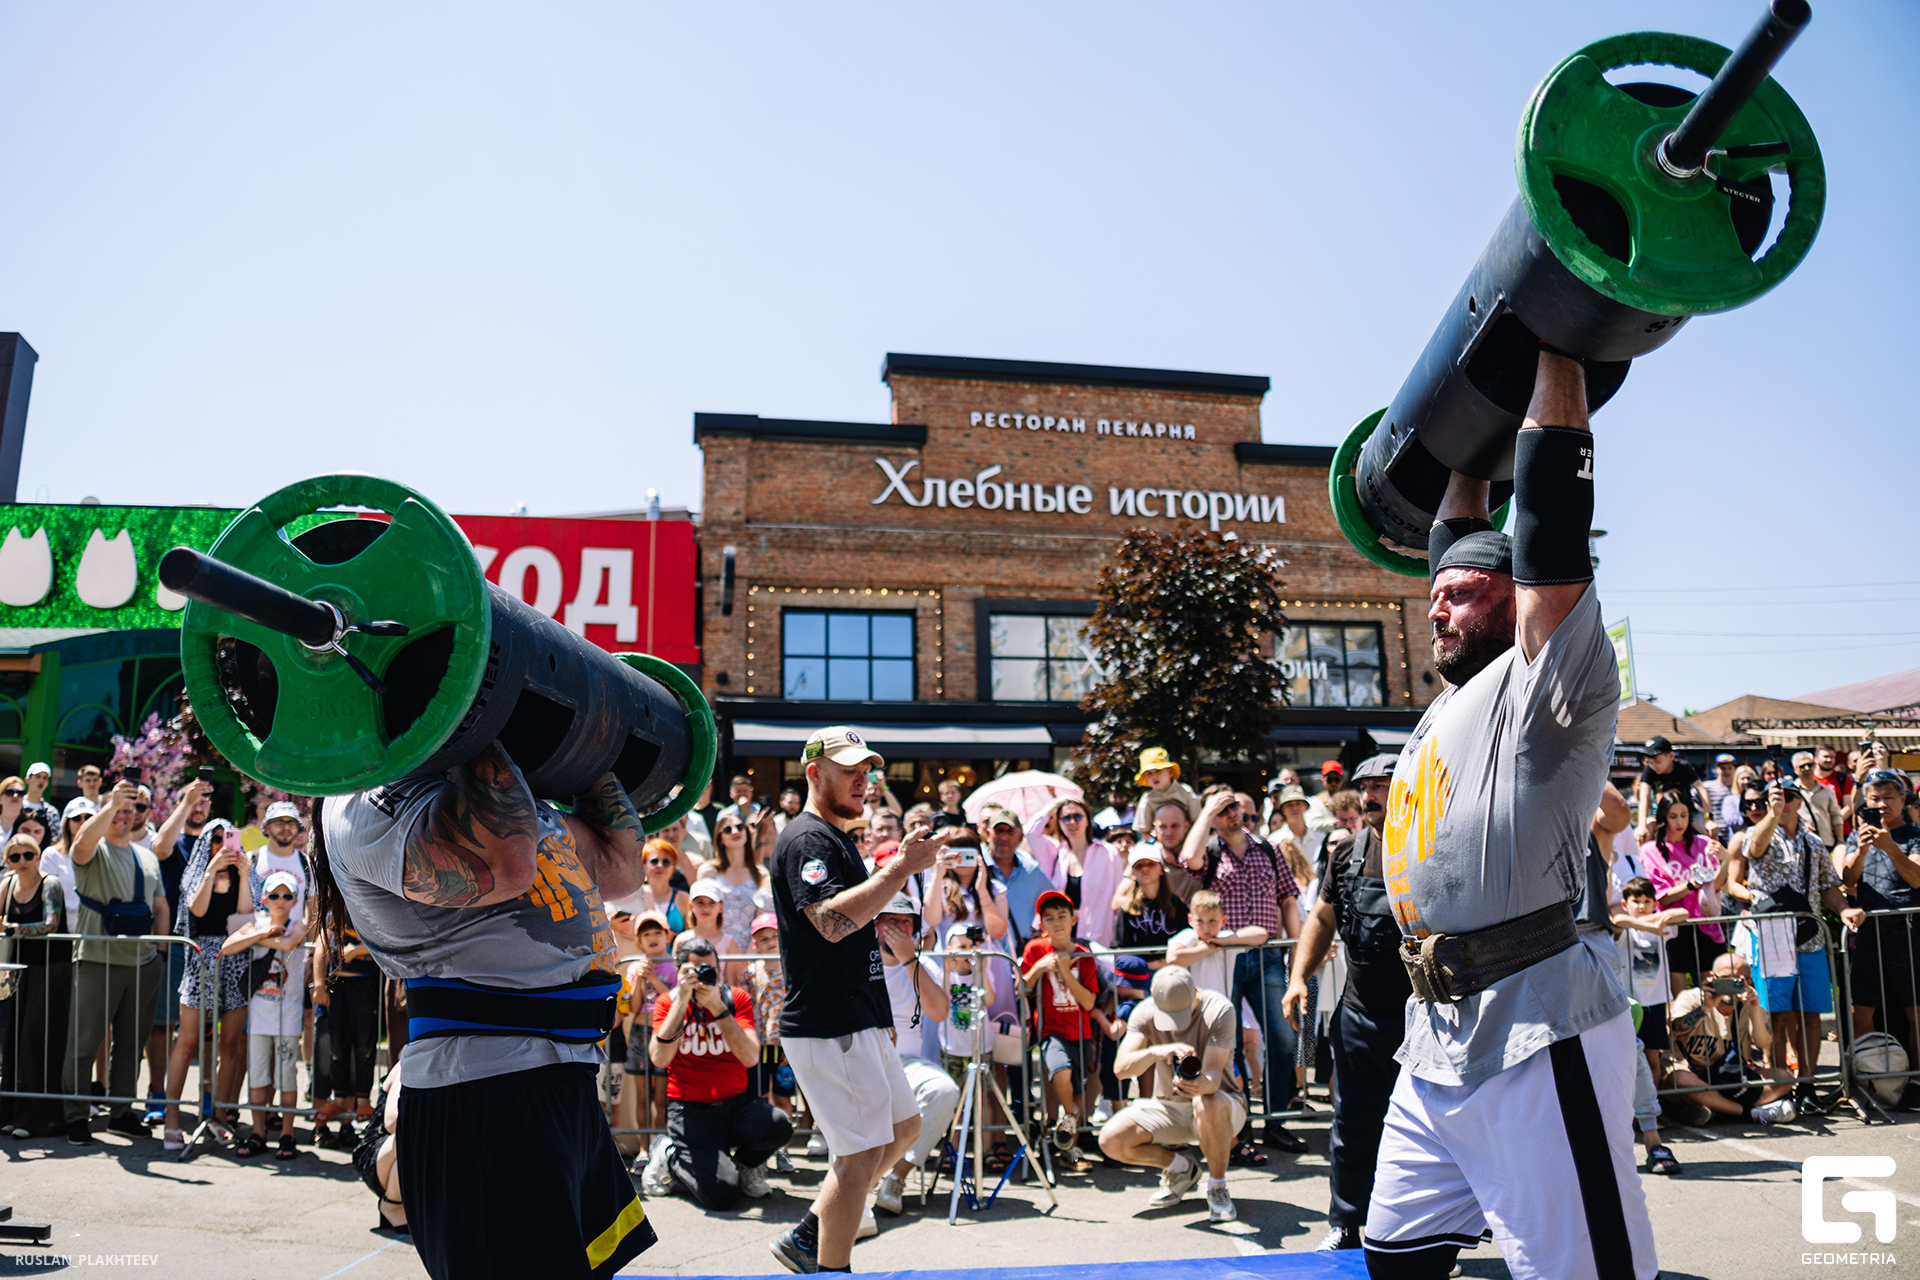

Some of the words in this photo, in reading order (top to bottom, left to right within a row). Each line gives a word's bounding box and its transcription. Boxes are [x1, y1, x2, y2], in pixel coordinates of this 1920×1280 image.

[1723, 187, 1760, 203] STECTER
[970, 411, 1086, 433] РЕСТОРАН
[1097, 418, 1196, 440] ПЕКАРНЯ
[871, 458, 1093, 515] Хлебные
[1108, 486, 1287, 532] истории
